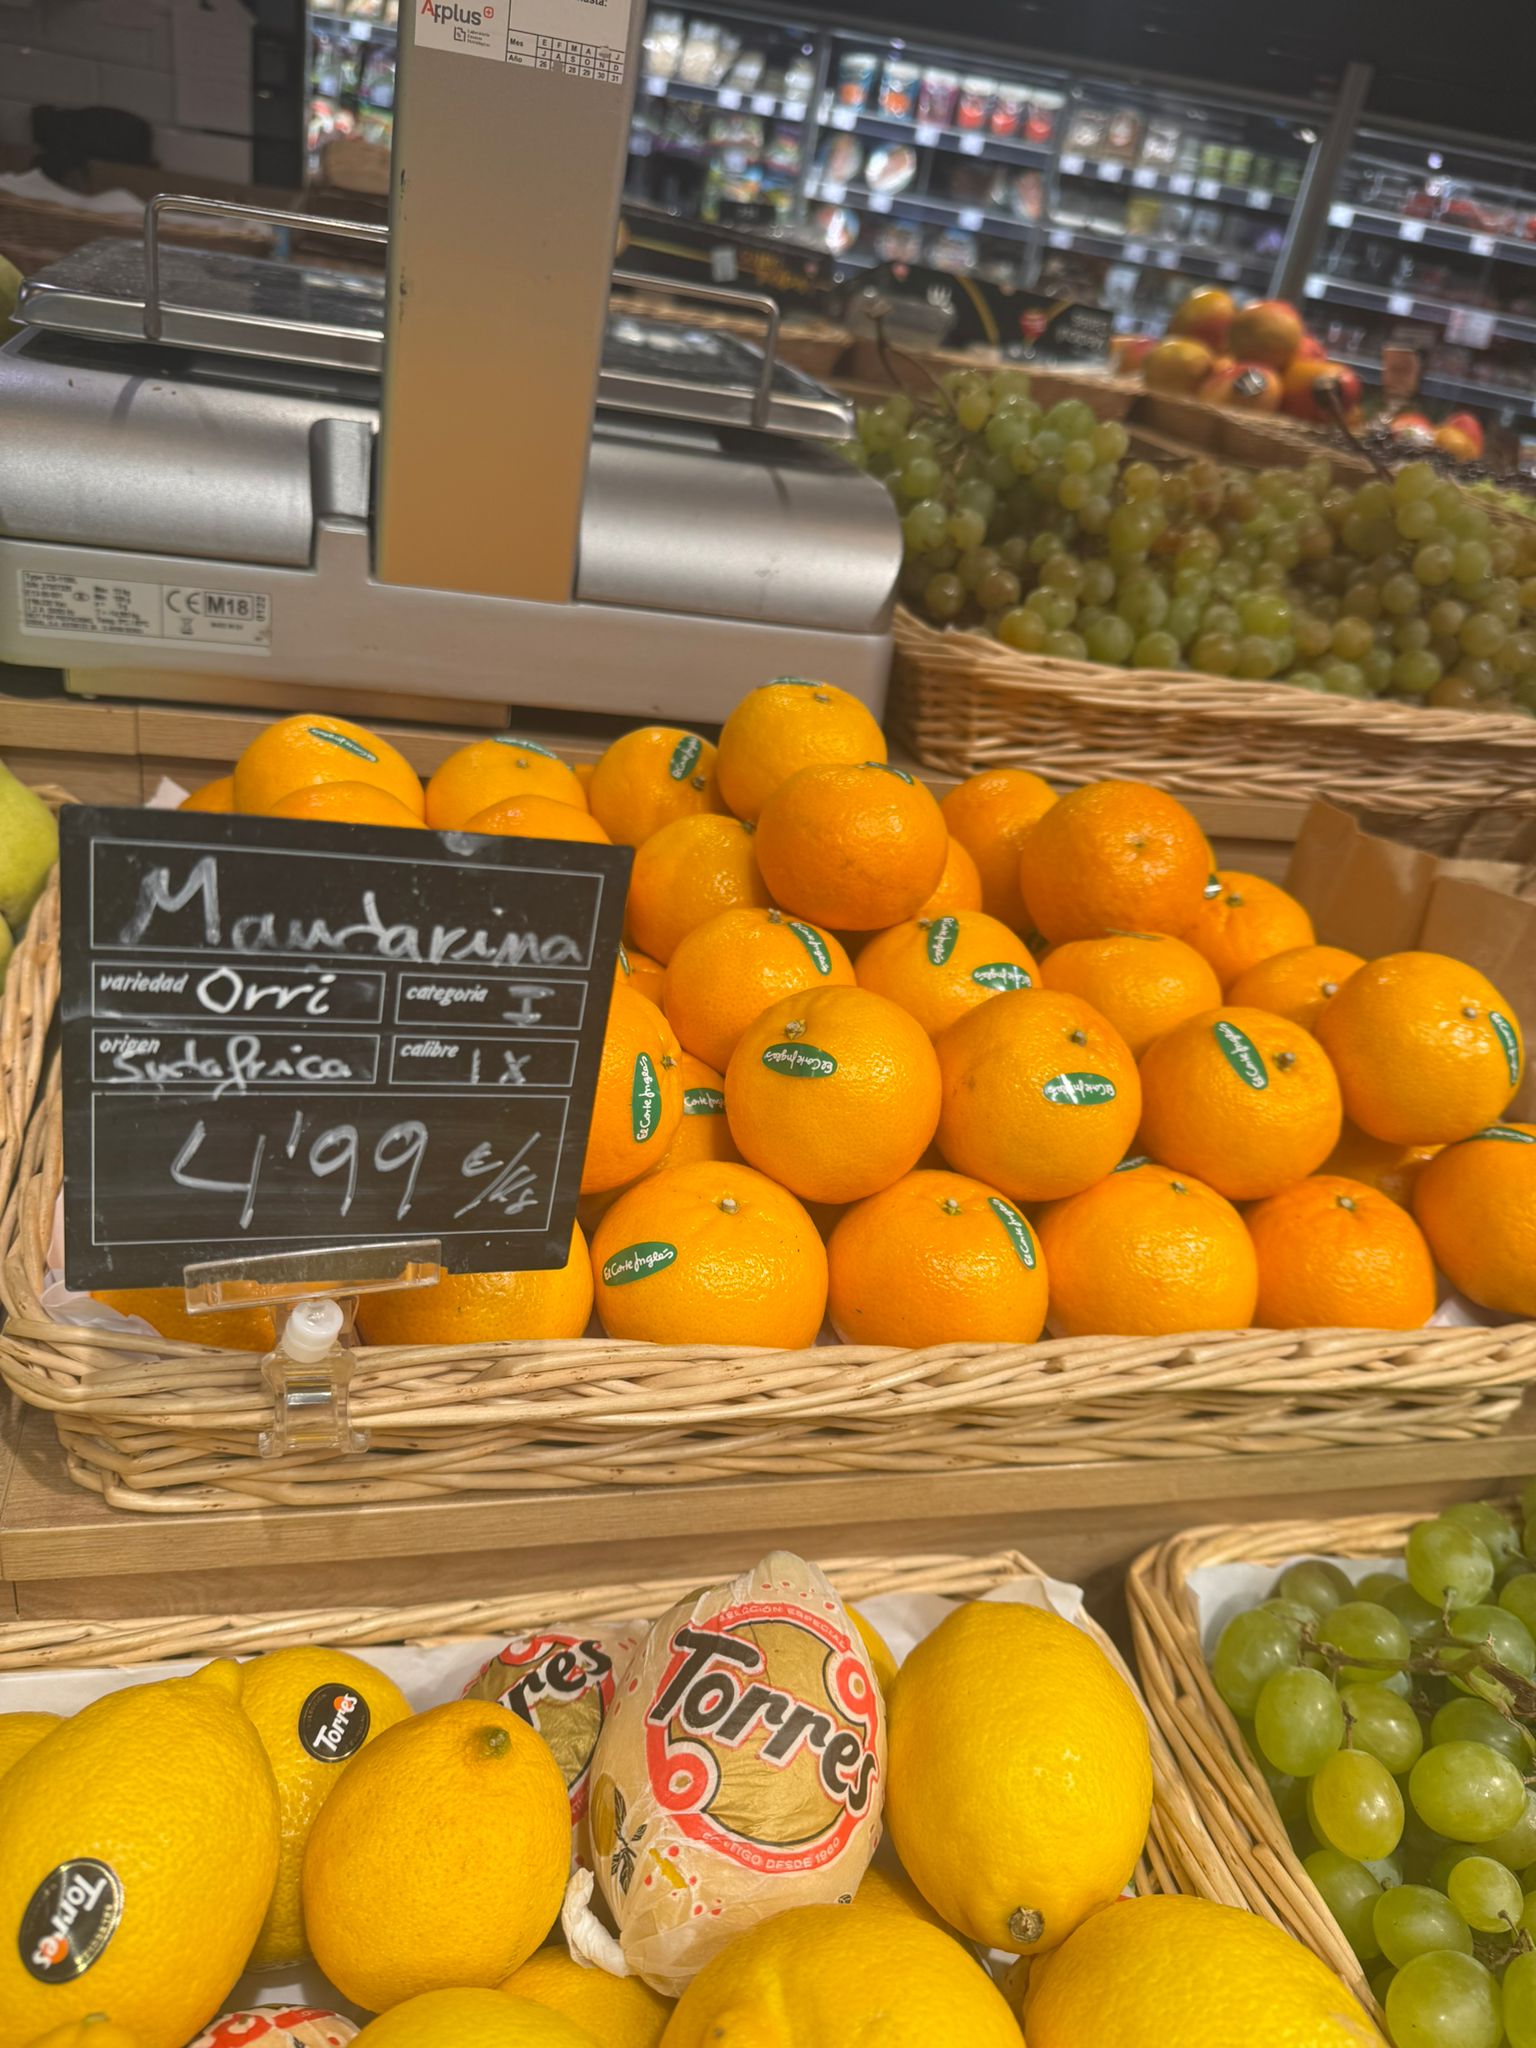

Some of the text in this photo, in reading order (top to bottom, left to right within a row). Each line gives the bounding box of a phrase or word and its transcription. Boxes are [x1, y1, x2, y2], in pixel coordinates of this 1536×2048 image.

[207, 595, 249, 616] M18
[121, 856, 583, 966] Mandarina
[100, 965, 337, 1015] variedad Orri
[100, 1033, 161, 1056] origen
[400, 1040, 460, 1058] calibre
[764, 1048, 799, 1070] Inglés
[796, 1055, 821, 1070] Corte
[636, 1055, 656, 1141] El Corte Inglés
[170, 1110, 428, 1229] 4'99
[603, 1247, 674, 1281] El Corte Inglés
[499, 1640, 613, 1728] res
[312, 1692, 359, 1753] Torres
[649, 1628, 876, 1812] Torres
[765, 1856, 813, 1870] DESDE
[31, 1873, 108, 1971] Torres
